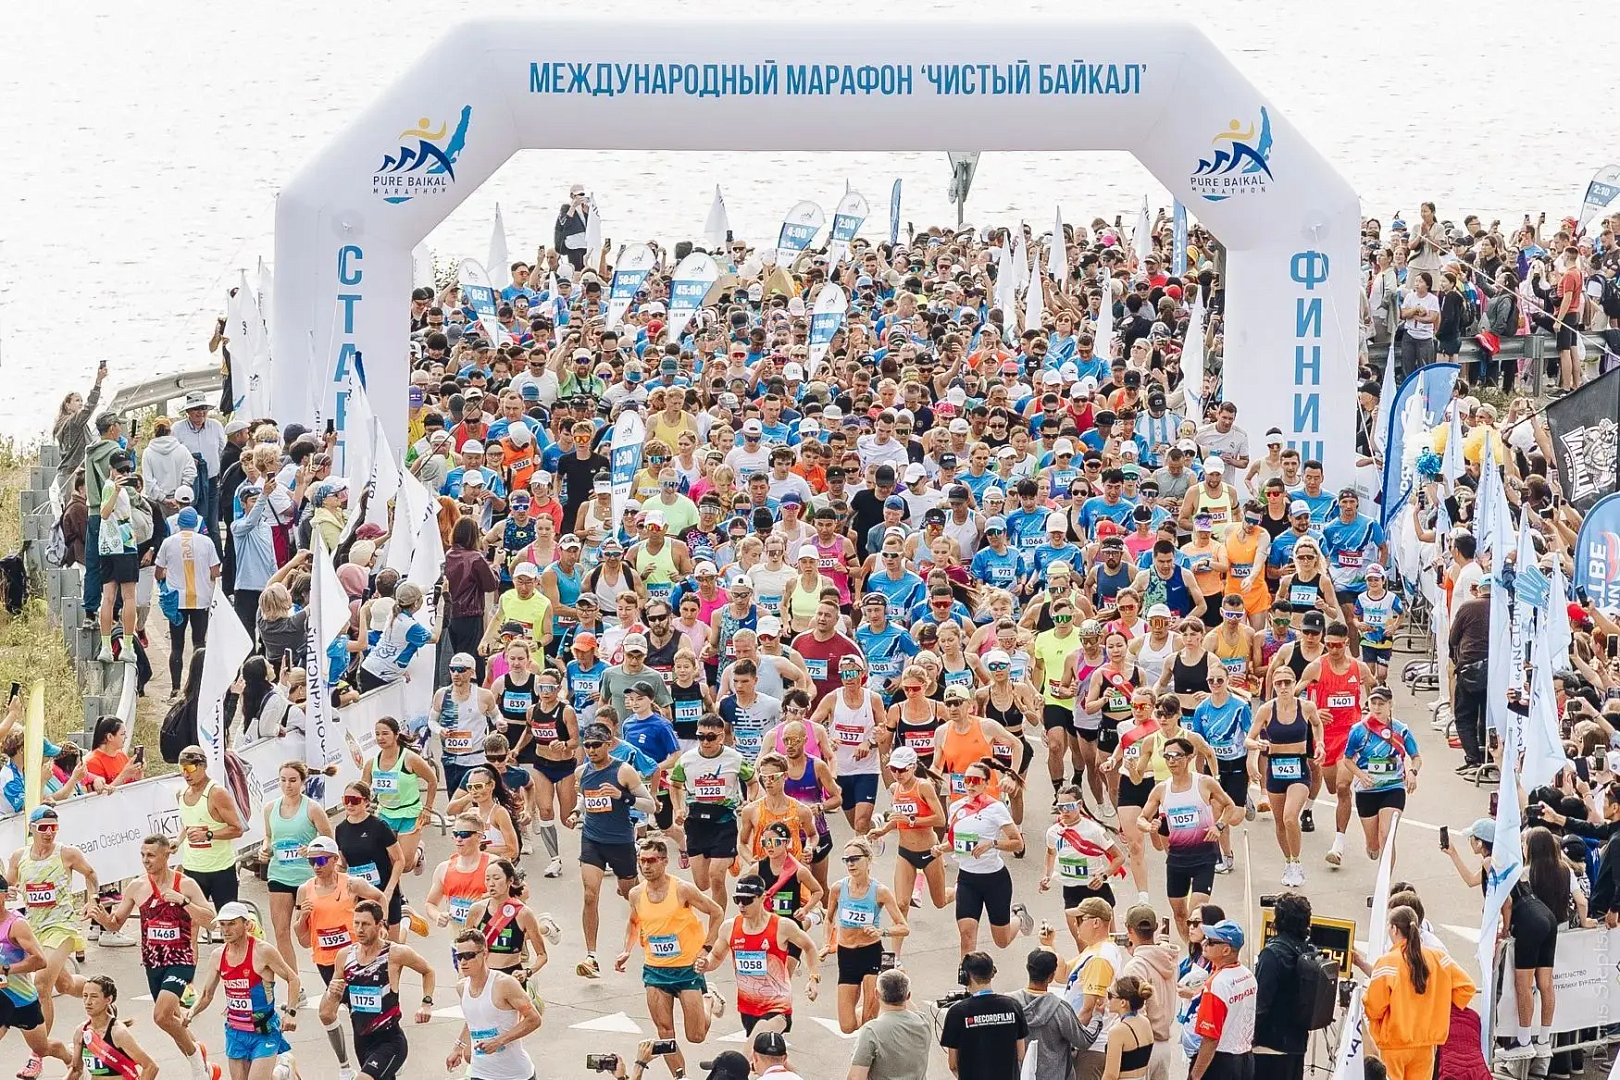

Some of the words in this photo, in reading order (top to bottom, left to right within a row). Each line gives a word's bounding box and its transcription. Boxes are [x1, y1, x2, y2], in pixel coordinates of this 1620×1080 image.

[529, 59, 778, 97] МЕЖДУНАРОДНЫЙ
[786, 63, 913, 96] МАРАФОН
[373, 175, 403, 187] PURE
[407, 175, 447, 188] BAIKAL
[1190, 176, 1219, 187] PURE
[1224, 175, 1265, 187] BAIKAL
[373, 187, 447, 195] MARATHON
[1191, 186, 1267, 194] MARATHON
[676, 284, 702, 296] 45:00
[1024, 538, 1043, 546] 1066
[1342, 556, 1359, 565] 1375
[998, 568, 1011, 576] 973
[1297, 593, 1311, 601] 727
[1368, 615, 1382, 623] 732
[872, 663, 889, 671] 1081
[1227, 664, 1241, 672] 967
[578, 681, 593, 690] 705
[509, 700, 525, 708] 839
[1112, 698, 1123, 706] 16
[1332, 697, 1351, 706] 1401
[682, 708, 698, 716] 1121
[535, 729, 553, 737] 1300
[840, 732, 859, 741] 1337
[448, 739, 469, 747] 2049
[911, 738, 931, 747] 1479
[1126, 747, 1137, 755] 20
[1278, 765, 1294, 774] 943
[377, 780, 391, 788] 832
[700, 787, 720, 795] 1228
[1174, 814, 1194, 824] 1057
[29, 891, 51, 901] 1240
[849, 911, 866, 922] 725
[152, 929, 175, 939] 1468
[322, 934, 345, 945] 1395
[654, 943, 674, 952] 1169
[739, 960, 762, 970] 1058
[354, 995, 375, 1006] 1175
